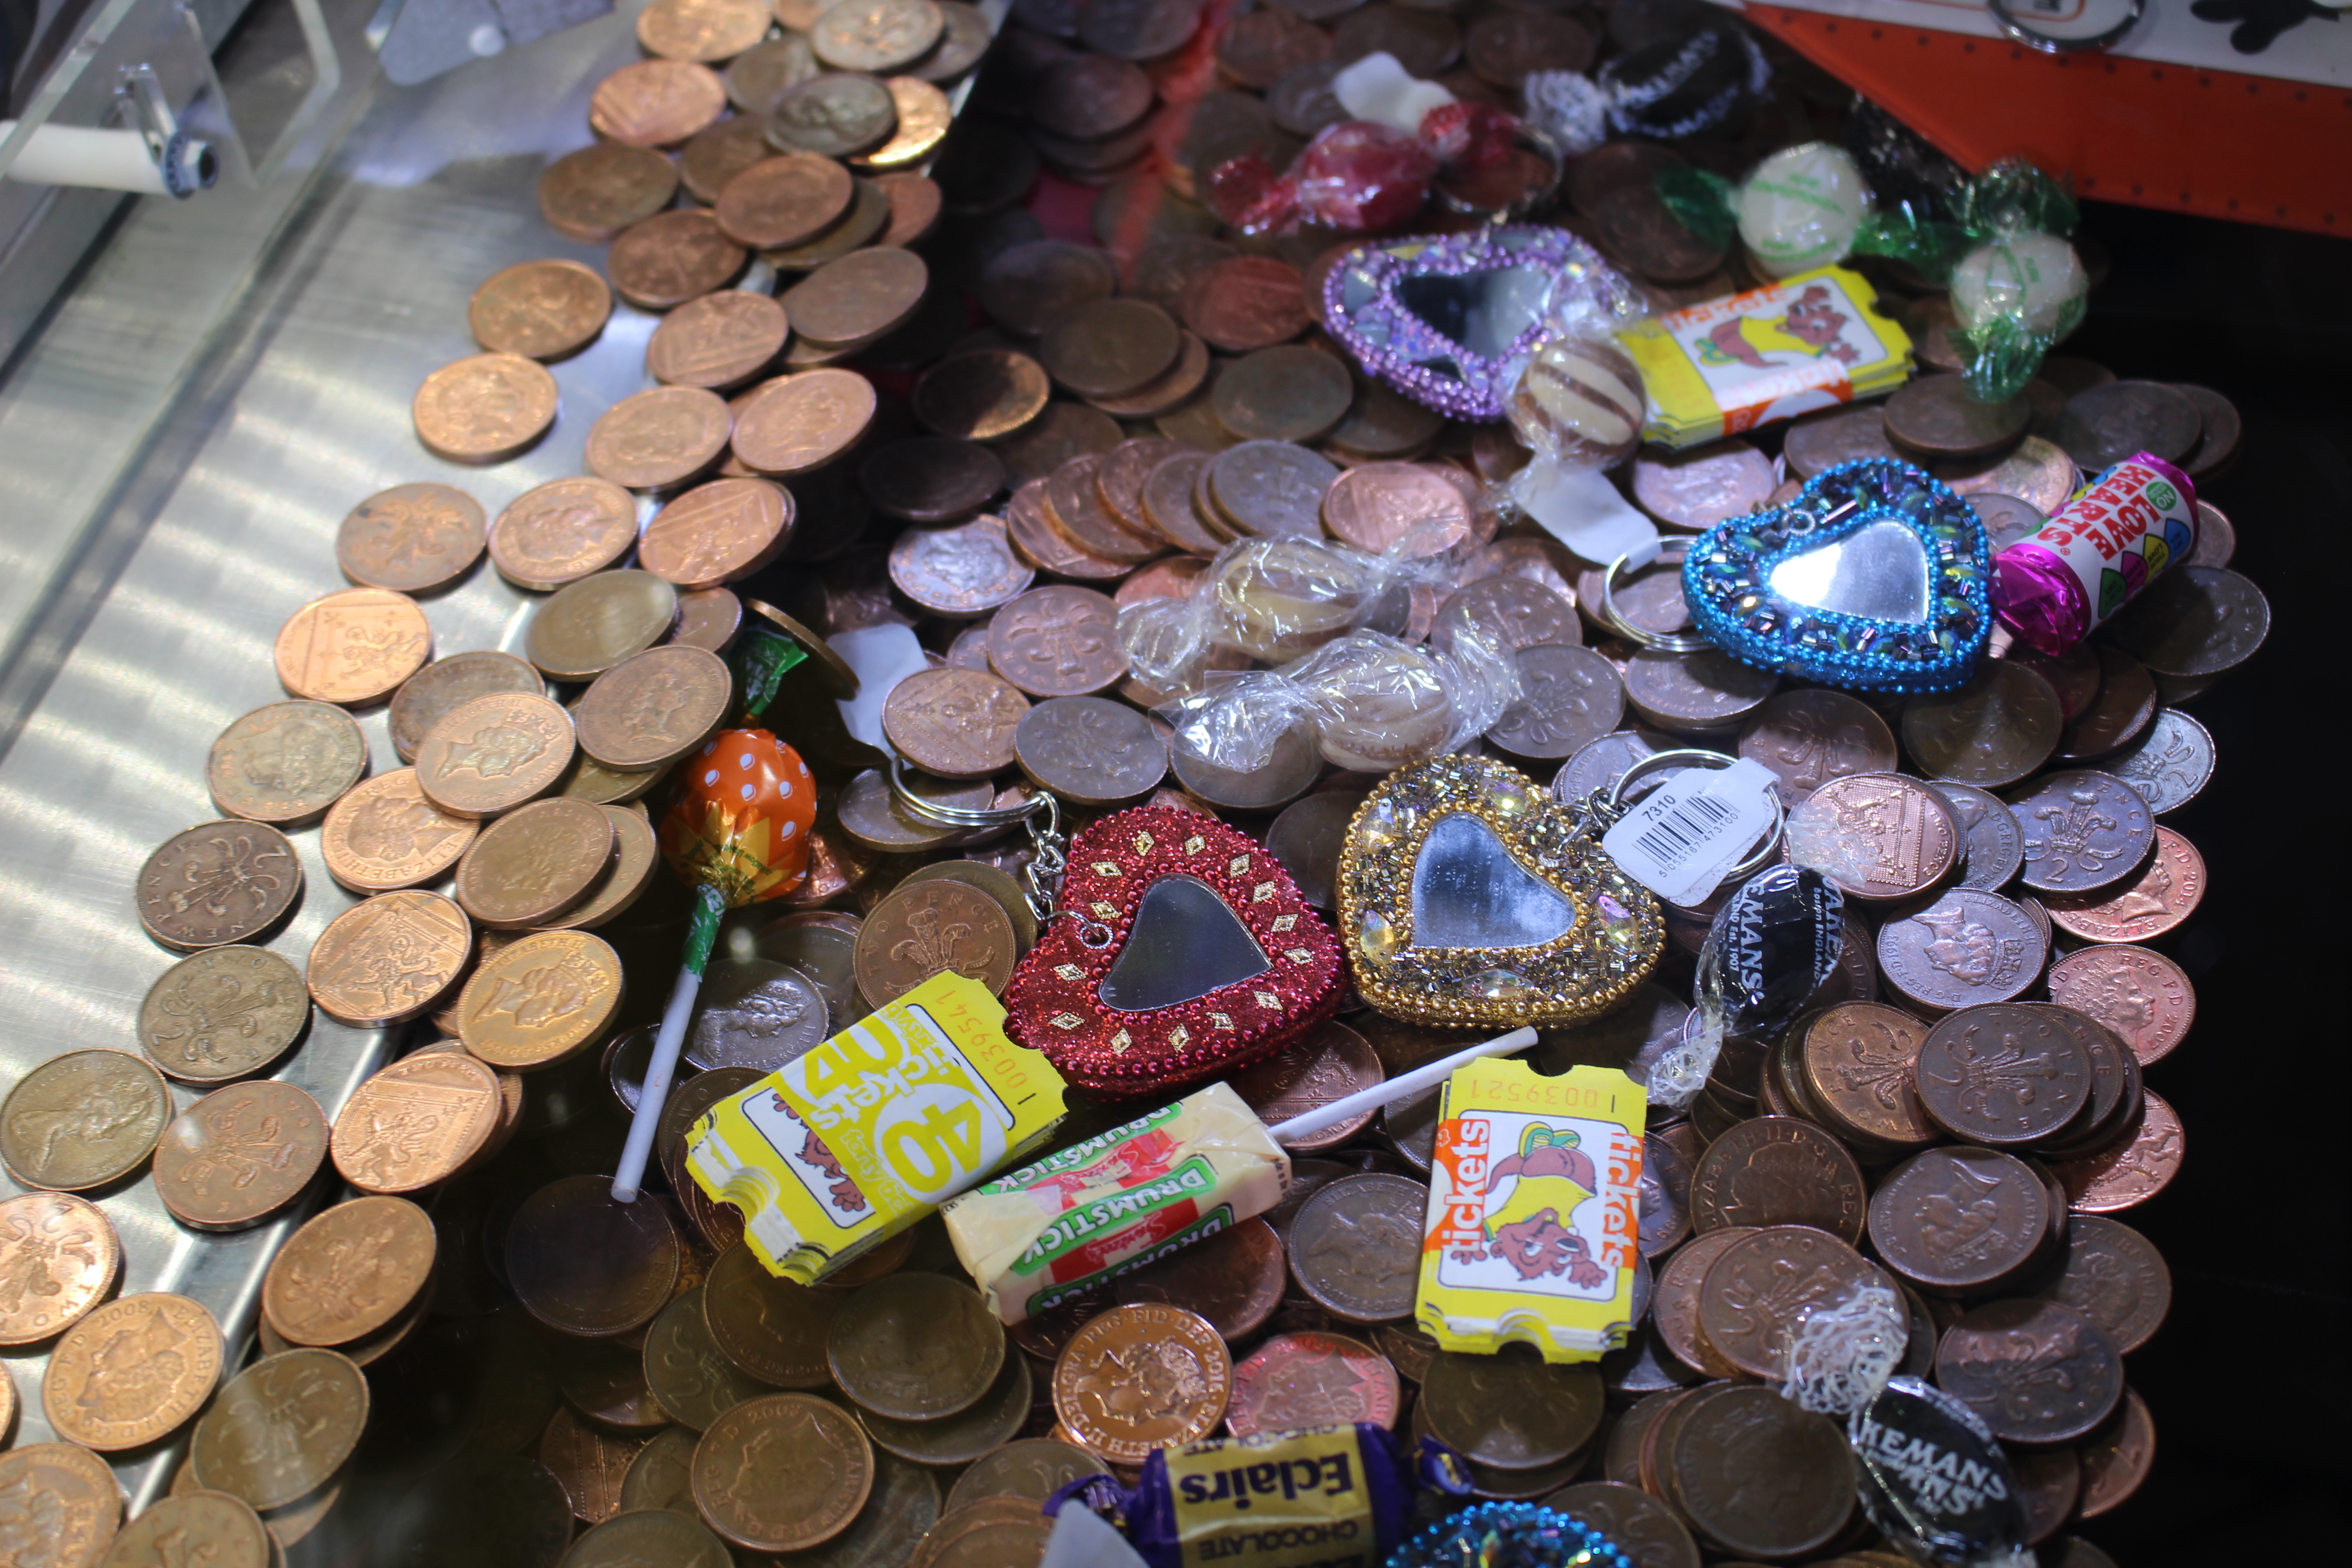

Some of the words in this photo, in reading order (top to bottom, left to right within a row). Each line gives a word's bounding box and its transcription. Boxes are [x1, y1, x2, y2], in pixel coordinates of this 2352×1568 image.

[2038, 465, 2156, 546] HEARTS
[2085, 494, 2161, 561] LOVE
[1641, 794, 1676, 822] 7310
[864, 920, 890, 976] TWO
[902, 891, 998, 934] PENCE
[1729, 947, 1740, 972] 1907
[936, 990, 1029, 1090] 0039541
[1988, 1012, 2052, 1037] TWO
[809, 1041, 961, 1130] tickets
[1470, 1079, 1599, 1109] 0039521
[2018, 1050, 2079, 1130] PENCE
[881, 1099, 981, 1194] 40
[999, 1106, 1173, 1193] DRUMSTICK
[1441, 1119, 1490, 1252] tickets
[1023, 1166, 1208, 1266] DRUMSTICK
[1601, 1132, 1642, 1269] tickets
[1747, 1235, 1814, 1256] TWO
[98, 1300, 151, 1328] 2008
[1060, 1350, 1085, 1386] GRA
[1084, 1315, 1122, 1345] REG
[1132, 1309, 1168, 1323] FID
[1175, 1316, 1213, 1345] DEF
[1205, 1350, 1225, 1393] 2016
[1179, 1451, 1353, 1510] Eclairs
[1198, 1519, 1359, 1562] CHOCOLATE
